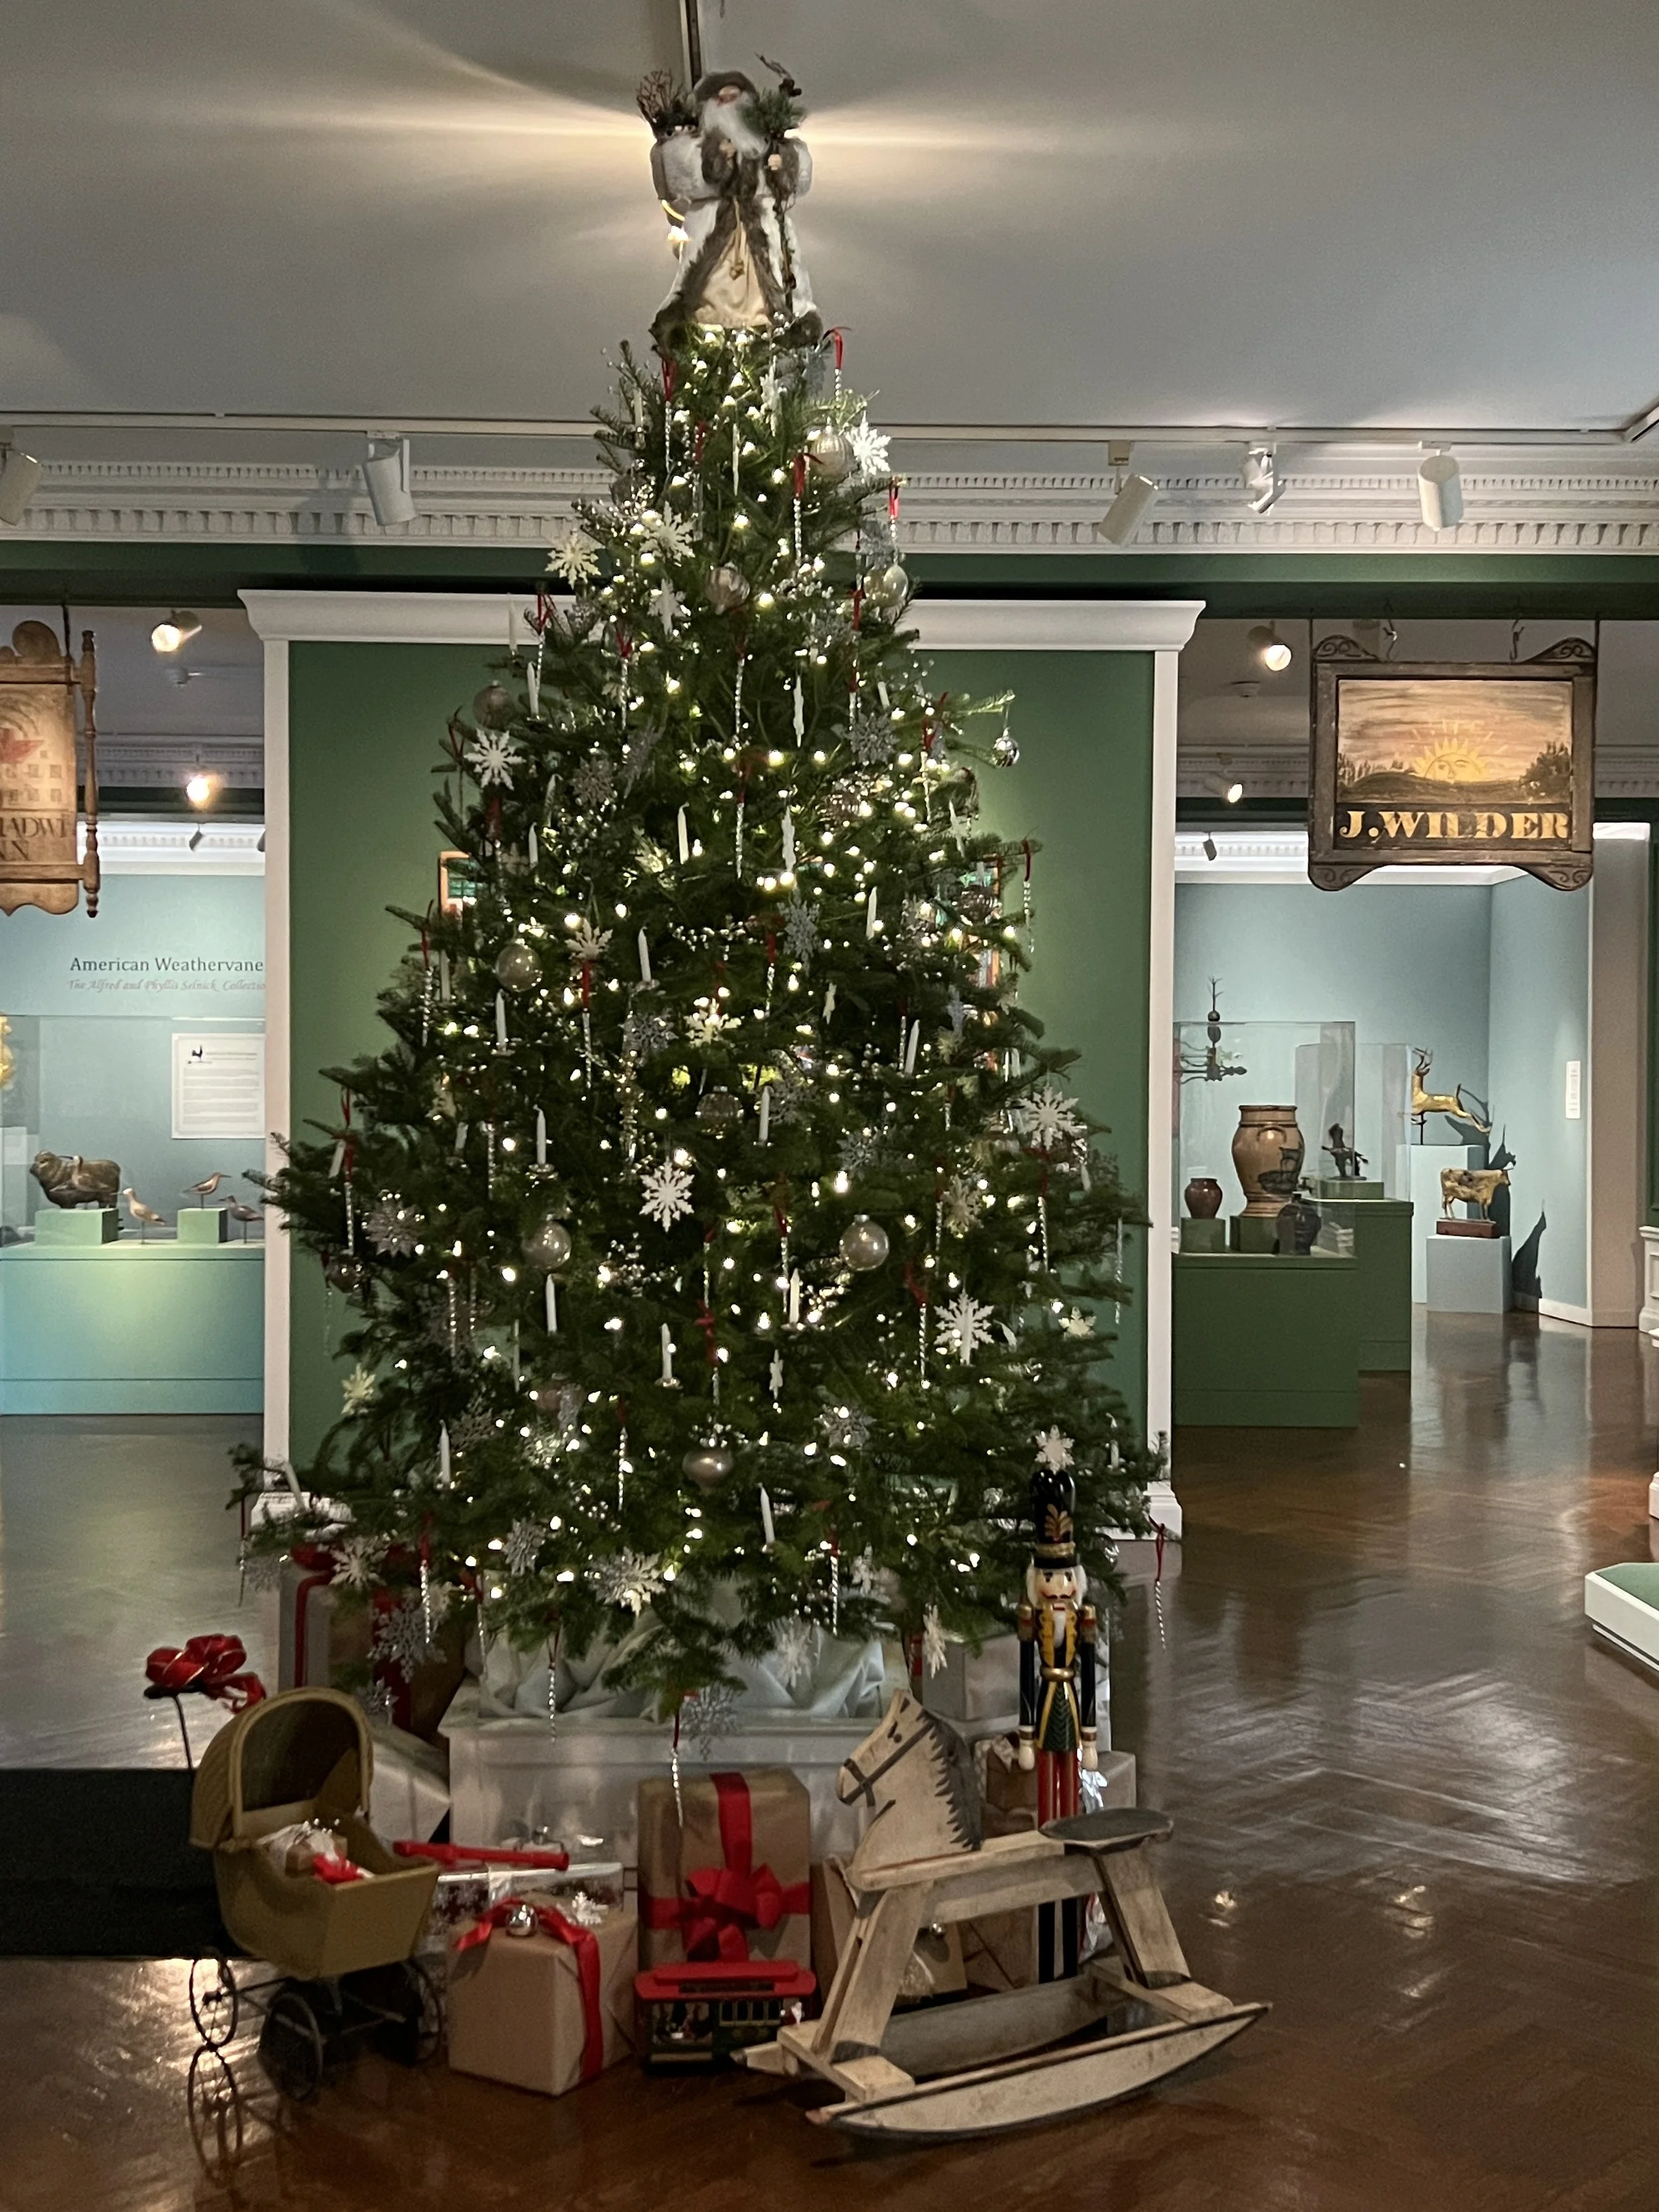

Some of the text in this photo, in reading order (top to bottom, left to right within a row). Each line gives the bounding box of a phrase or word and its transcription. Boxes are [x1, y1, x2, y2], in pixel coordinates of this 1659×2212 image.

[70, 956, 263, 971] American Weathervane
[68, 979, 86, 990] The
[88, 979, 122, 993] Alfred
[122, 979, 143, 990] and
[144, 979, 179, 993] Phyllis
